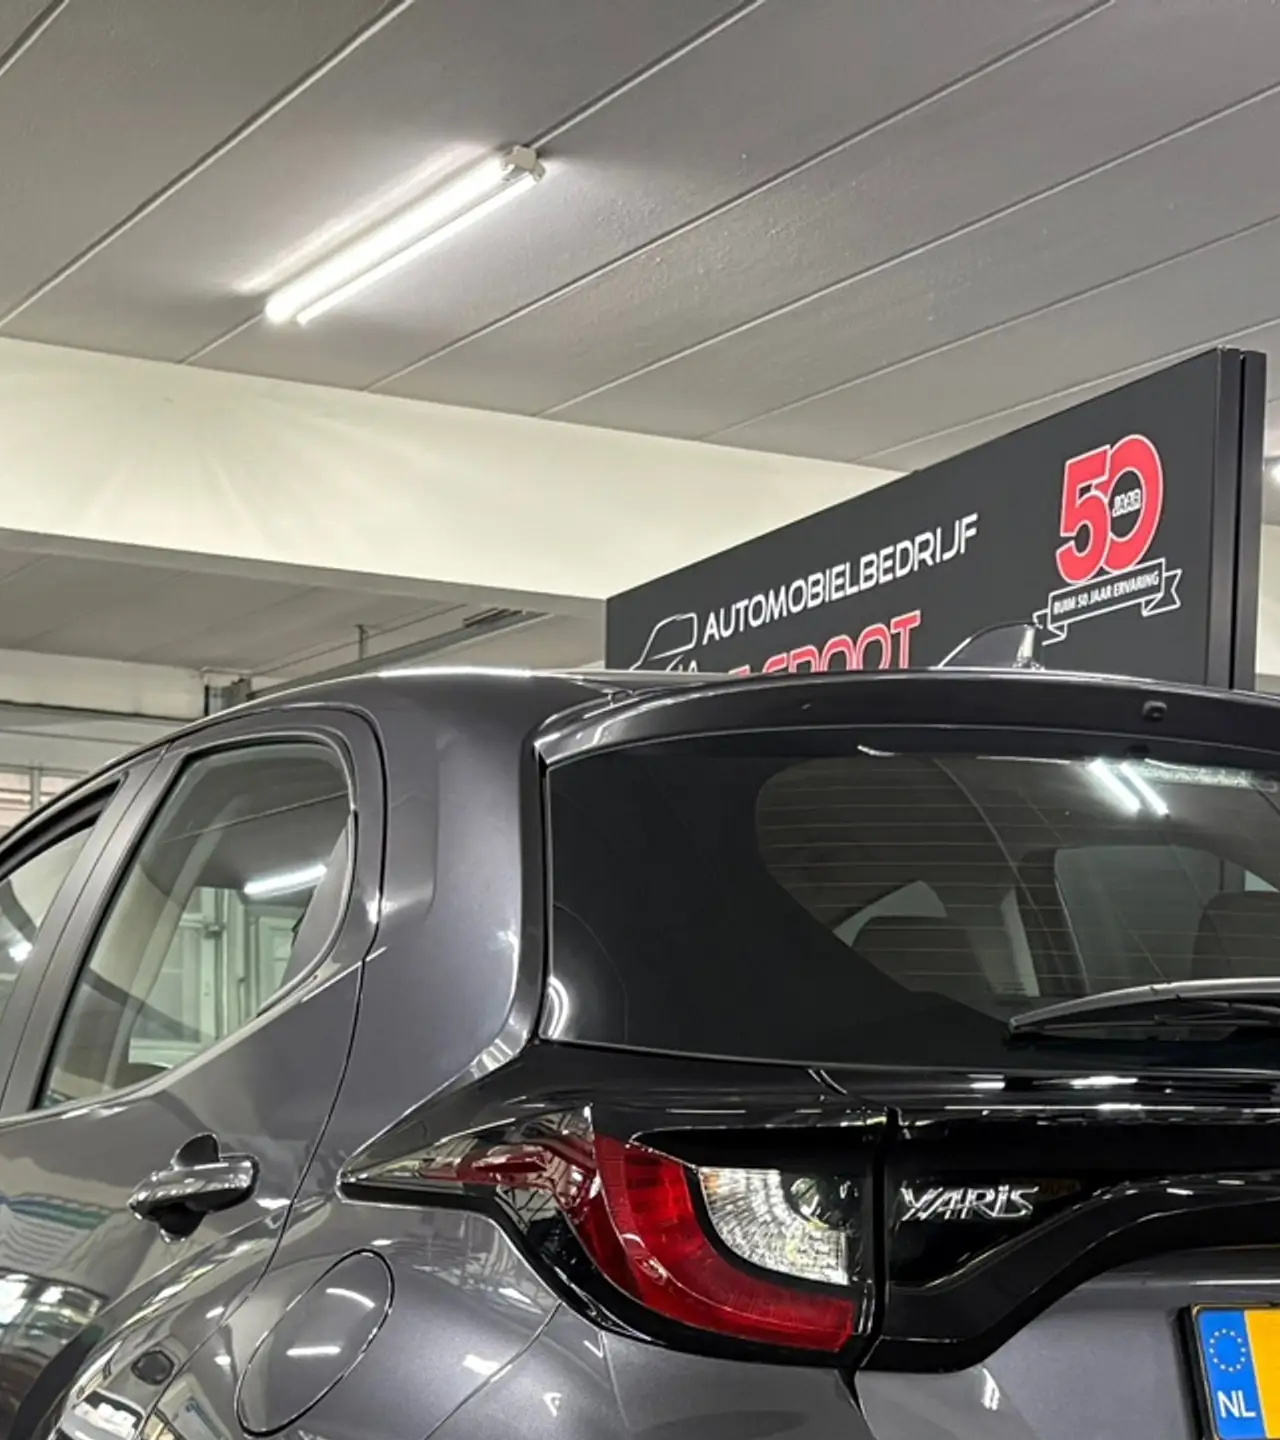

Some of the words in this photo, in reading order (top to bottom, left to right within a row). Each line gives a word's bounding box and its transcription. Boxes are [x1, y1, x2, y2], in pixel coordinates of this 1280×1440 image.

[1056, 434, 1163, 583] 50
[702, 512, 979, 645] AUTOMOBIELBEDRIJF
[1078, 592, 1088, 608] 50
[1088, 586, 1112, 606] JAAR
[1113, 571, 1159, 598] ERVARING
[1217, 1390, 1257, 1418] NL
